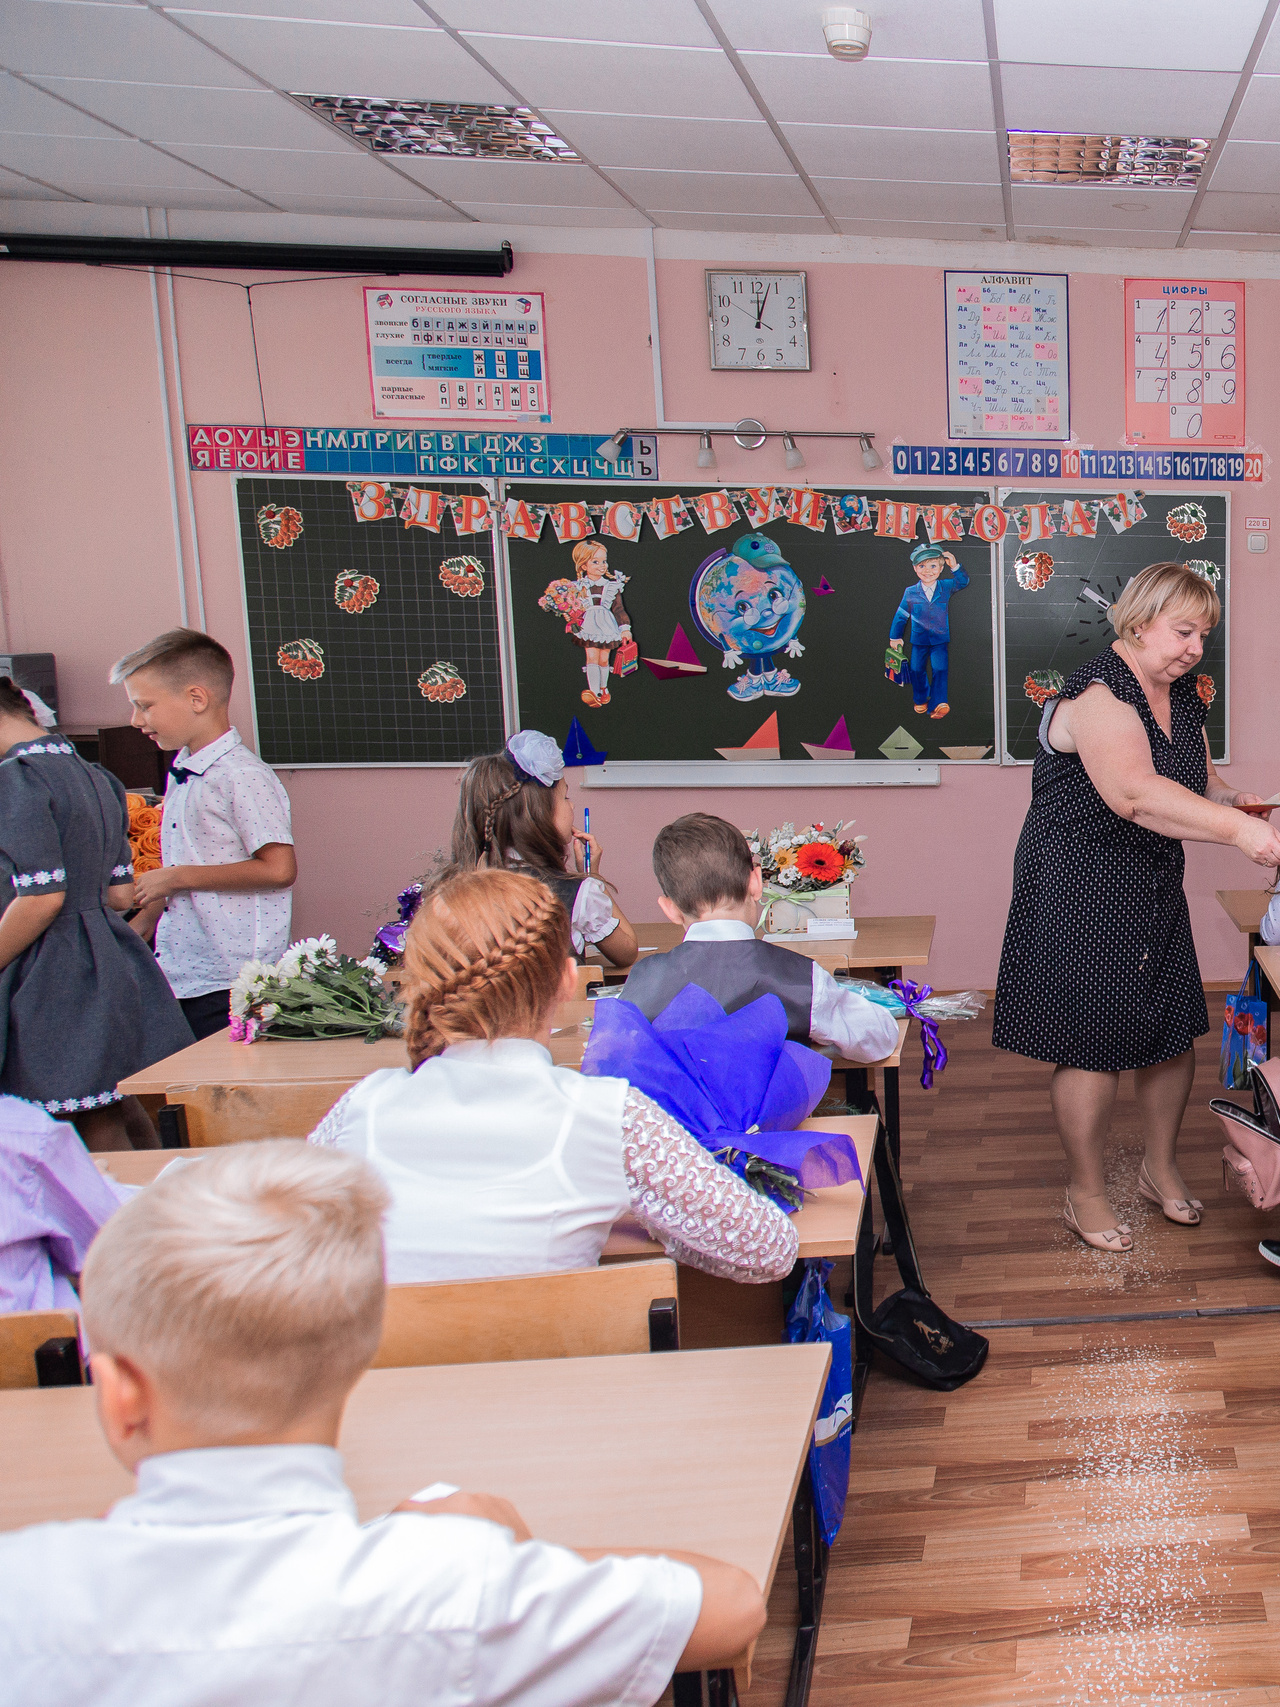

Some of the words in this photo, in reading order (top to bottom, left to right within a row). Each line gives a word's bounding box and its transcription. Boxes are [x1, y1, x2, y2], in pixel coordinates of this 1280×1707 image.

[981, 276, 1033, 285] АЛФАВИТ
[733, 281, 743, 294] 11
[751, 281, 763, 294] 12
[774, 282, 779, 294] 1
[1162, 286, 1207, 295] ЦИФРЫ
[401, 295, 467, 305] СОГЛАСНЫЕ
[472, 297, 508, 307] ЗВУКИ
[718, 295, 731, 308] 10
[787, 296, 796, 309] 2
[1136, 300, 1141, 308] 1
[1170, 301, 1176, 309] 2
[1205, 302, 1210, 311] 3
[415, 306, 462, 314] РУССКОГО
[465, 307, 497, 315] ЯЗЫКА
[412, 318, 419, 328] б
[447, 321, 454, 330] д
[483, 321, 489, 330] й
[530, 324, 536, 333] р
[721, 315, 729, 327] 9
[788, 316, 796, 328] 3
[1156, 307, 1167, 332] 1
[1188, 308, 1202, 333] 2
[1221, 309, 1236, 334] 3
[423, 332, 433, 344] ф
[495, 337, 502, 345] ц
[517, 337, 527, 346] щ
[722, 334, 730, 347] 8
[789, 335, 797, 347] 4
[1136, 335, 1141, 343] 4
[1171, 336, 1176, 345] 5
[1204, 337, 1210, 346] 6
[738, 347, 746, 360] 7
[757, 349, 765, 361] 6
[776, 349, 783, 361] 5
[1155, 342, 1168, 367] 4
[1188, 343, 1202, 368] 5
[1221, 344, 1236, 369] 6
[1136, 370, 1141, 379] 7
[1171, 371, 1176, 380] 8
[1205, 372, 1210, 381] 9
[1155, 377, 1168, 402] 7
[1187, 378, 1202, 403] 8
[1221, 379, 1236, 404] 9
[896, 450, 907, 470] 0
[914, 451, 922, 470] 1
[931, 451, 941, 471] 2
[948, 452, 957, 471] 3
[964, 452, 975, 471] 4
[981, 453, 990, 472] 5
[998, 453, 1008, 472] 6
[1015, 453, 1025, 472] 7
[1031, 453, 1041, 473] 8
[1048, 454, 1058, 473] 9
[1063, 454, 1078, 474] 10
[1082, 454, 1096, 474] 11
[1100, 455, 1116, 475] 12
[1119, 455, 1134, 475] 13
[1138, 456, 1153, 475] 14
[1156, 456, 1171, 476] 15
[1174, 456, 1190, 476] 16
[1192, 457, 1208, 476] 17
[1210, 457, 1226, 477] 18
[1228, 457, 1243, 477] 19
[1245, 458, 1261, 478] 20
[357, 481, 825, 541] ЗДРАВСТВУЙ
[873, 491, 1130, 543] ШКОЛА!
